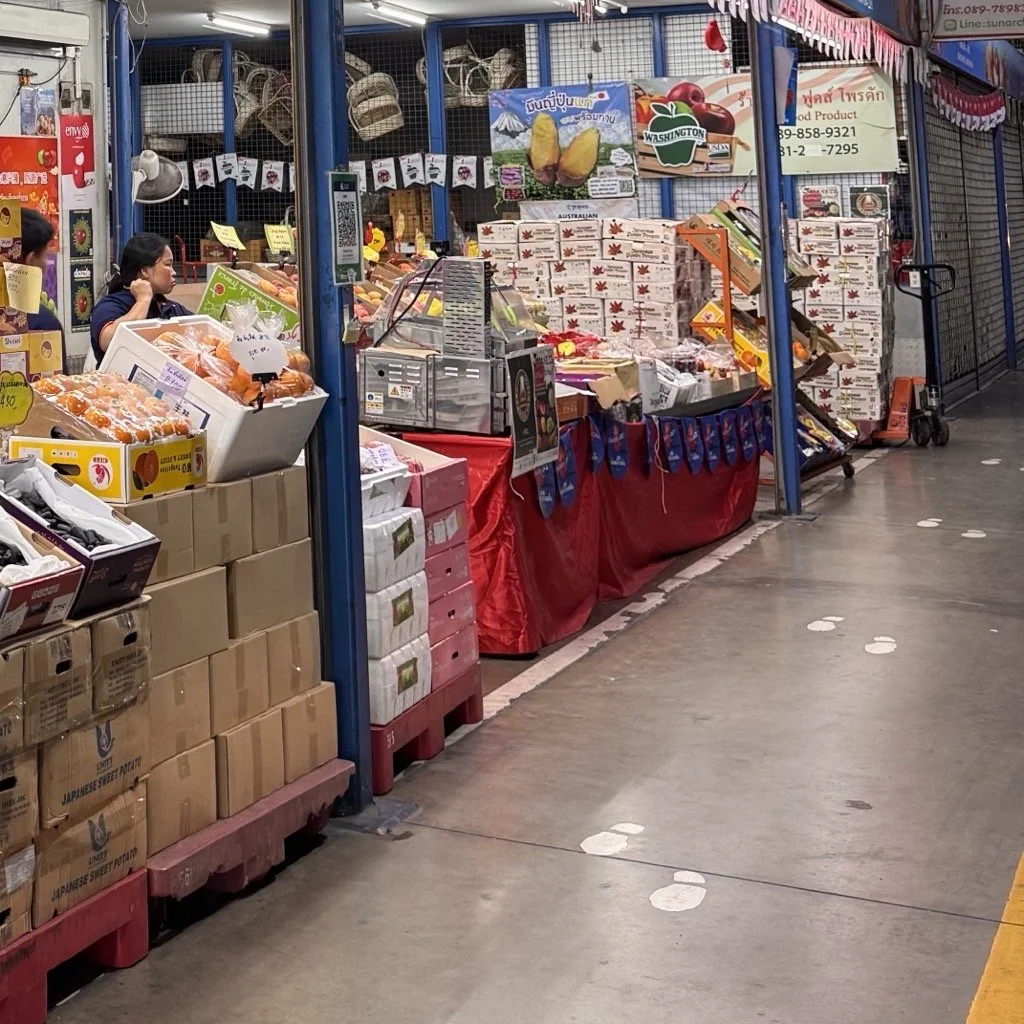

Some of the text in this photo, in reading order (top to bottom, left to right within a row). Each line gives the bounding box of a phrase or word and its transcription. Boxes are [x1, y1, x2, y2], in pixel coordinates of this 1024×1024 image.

[959, 18, 1024, 29] Line:sunarc
[797, 110, 858, 122] od Product
[65, 126, 82, 143] envy
[644, 126, 705, 144] WASHINGTON
[558, 212, 599, 220] AUSTRALIAN
[61, 755, 143, 806] JAPANESE SWEET POTATO
[51, 876, 88, 901] JAPANESE
[89, 862, 113, 882] SWEET
[113, 846, 138, 870] POTATO
